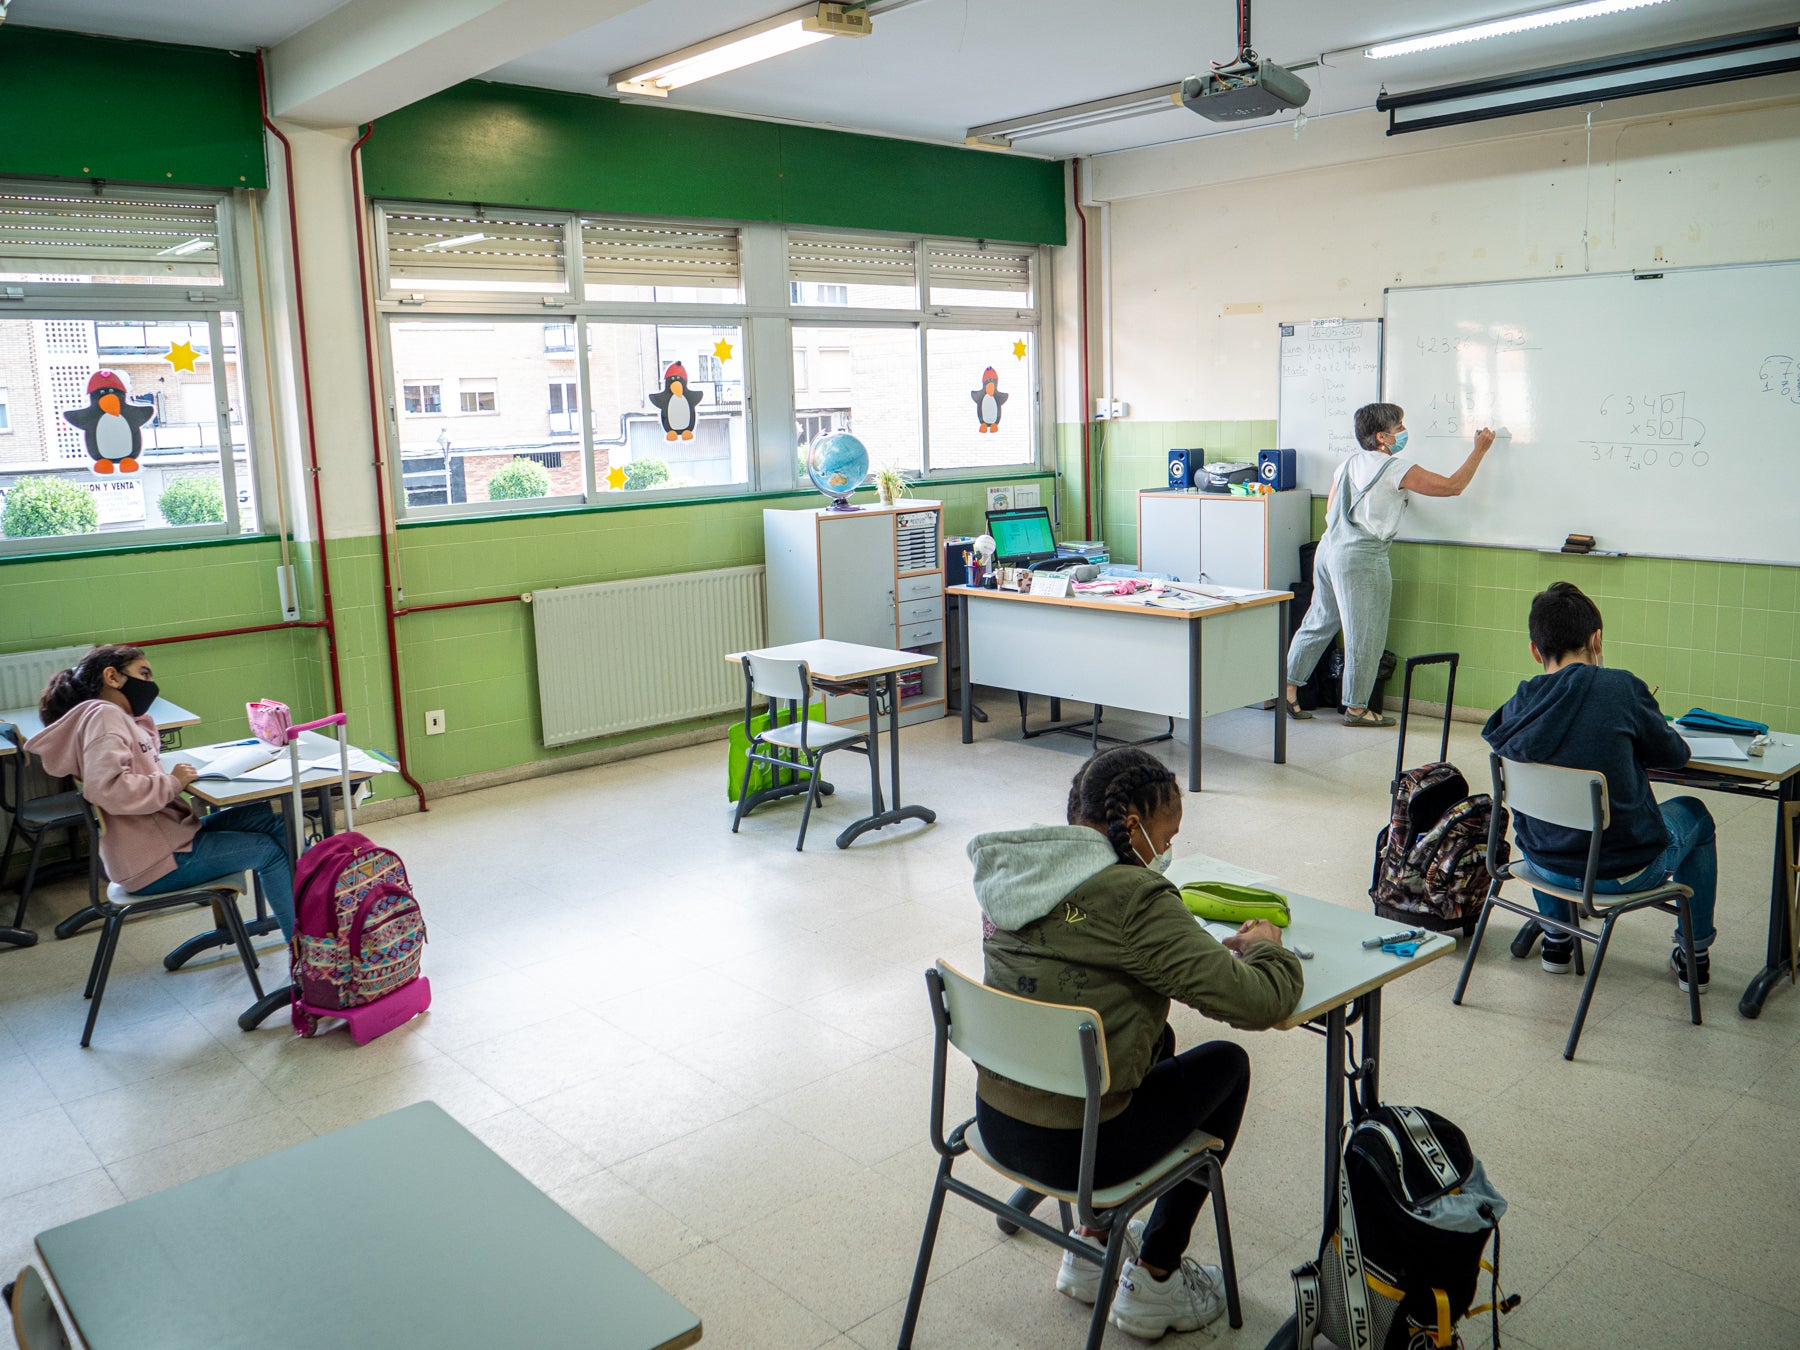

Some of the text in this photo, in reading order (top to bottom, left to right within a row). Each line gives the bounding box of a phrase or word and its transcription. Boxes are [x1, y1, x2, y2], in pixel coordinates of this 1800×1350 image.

[1600, 393, 1674, 415] 6340
[103, 483, 108, 491] Y
[112, 481, 134, 490] VENTA
[1421, 1137, 1446, 1175] FILA
[1344, 1237, 1358, 1278] FILA
[1303, 1289, 1315, 1328] FILA
[1353, 1307, 1367, 1349] FILA
